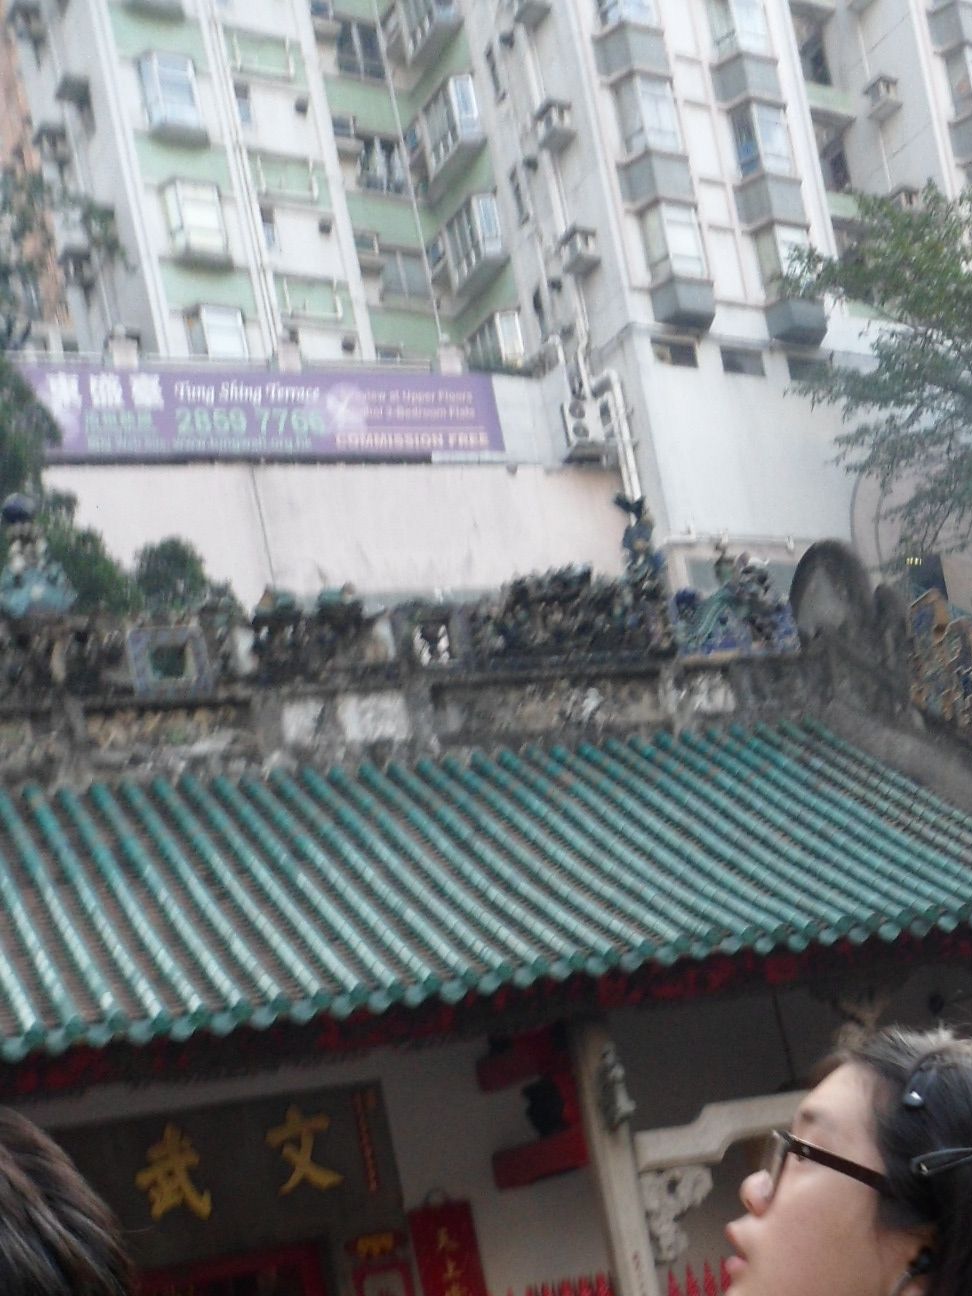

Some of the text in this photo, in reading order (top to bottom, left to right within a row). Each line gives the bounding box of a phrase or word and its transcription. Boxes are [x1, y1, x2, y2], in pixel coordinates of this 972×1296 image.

[174, 379, 215, 406] Tung
[219, 379, 262, 406] Shing
[265, 381, 320, 403] Terrace
[335, 430, 489, 449] COMMISSION FREE
